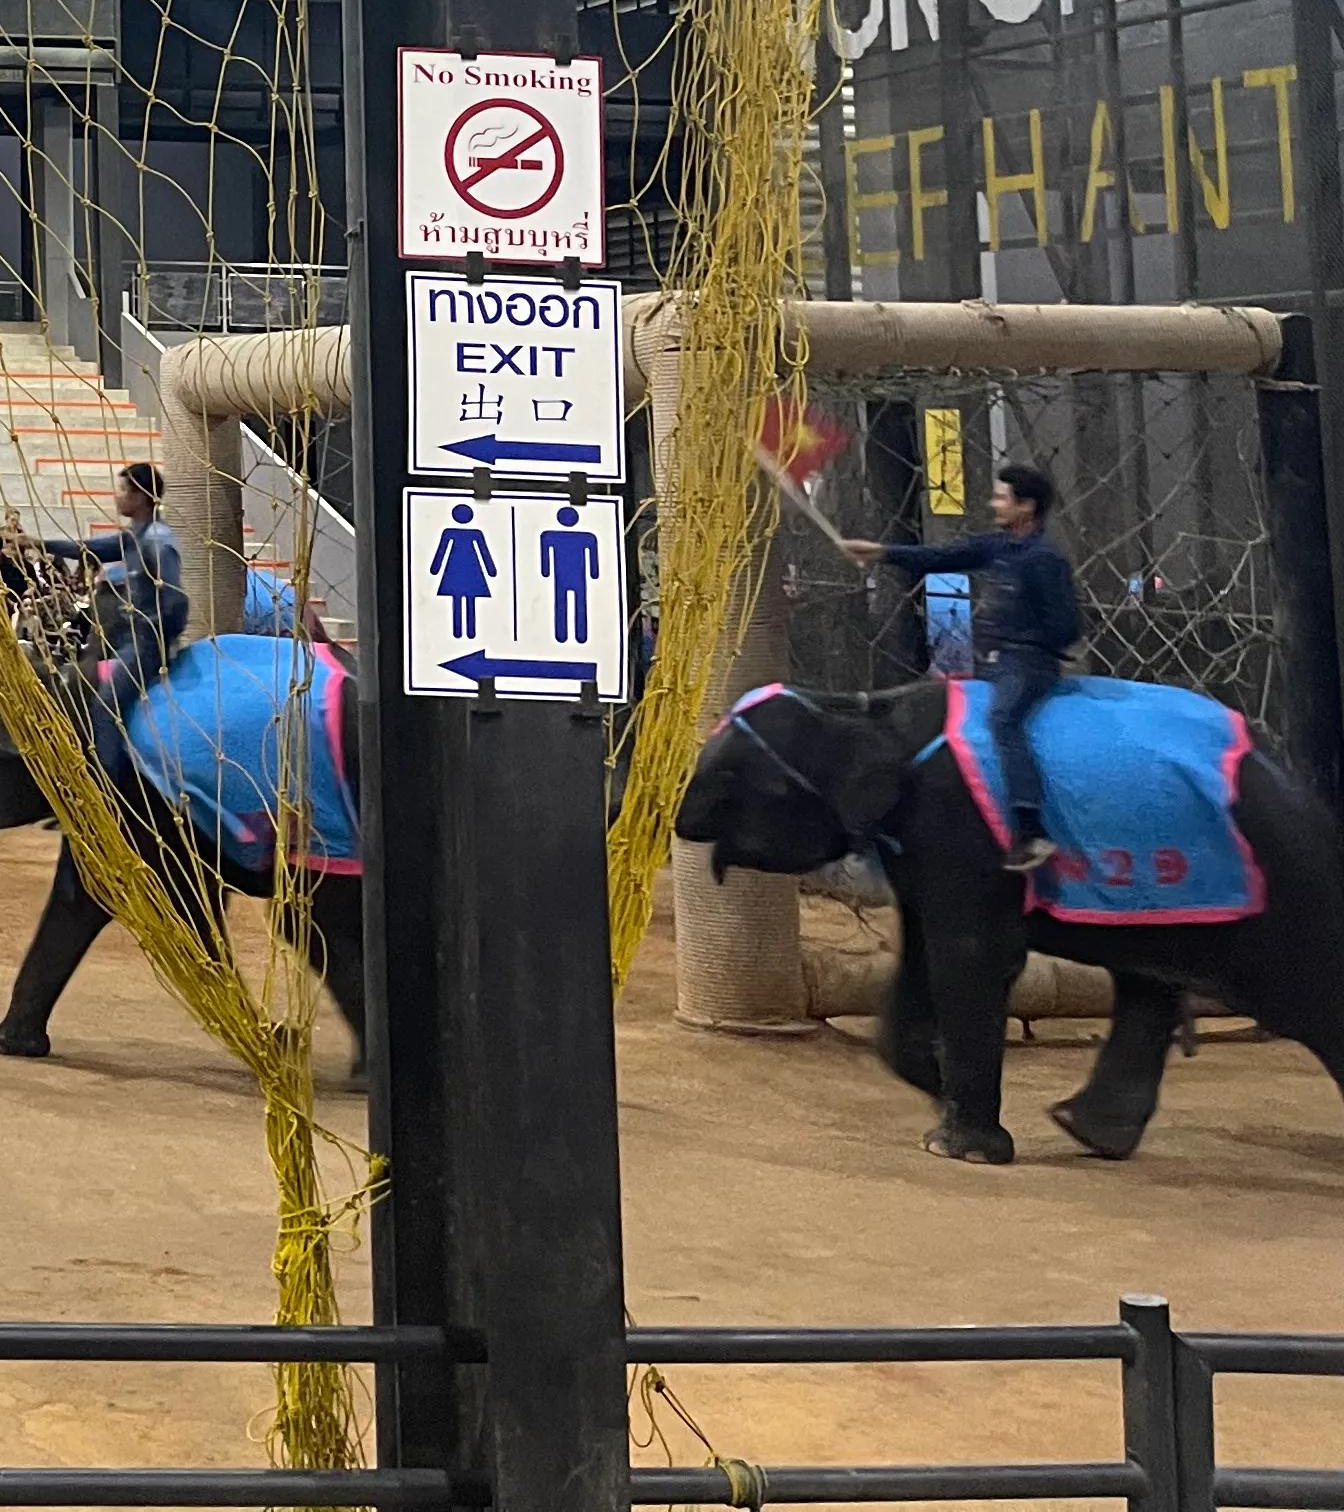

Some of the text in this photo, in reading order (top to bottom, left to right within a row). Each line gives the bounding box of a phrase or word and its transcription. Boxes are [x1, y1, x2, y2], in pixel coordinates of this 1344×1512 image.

[412, 63, 593, 98] No Smoking
[419, 211, 590, 257] ห้ามสูบบุหรี่
[429, 289, 600, 330] ทางออก
[456, 342, 576, 377] EXIT
[459, 383, 574, 425] 出口
